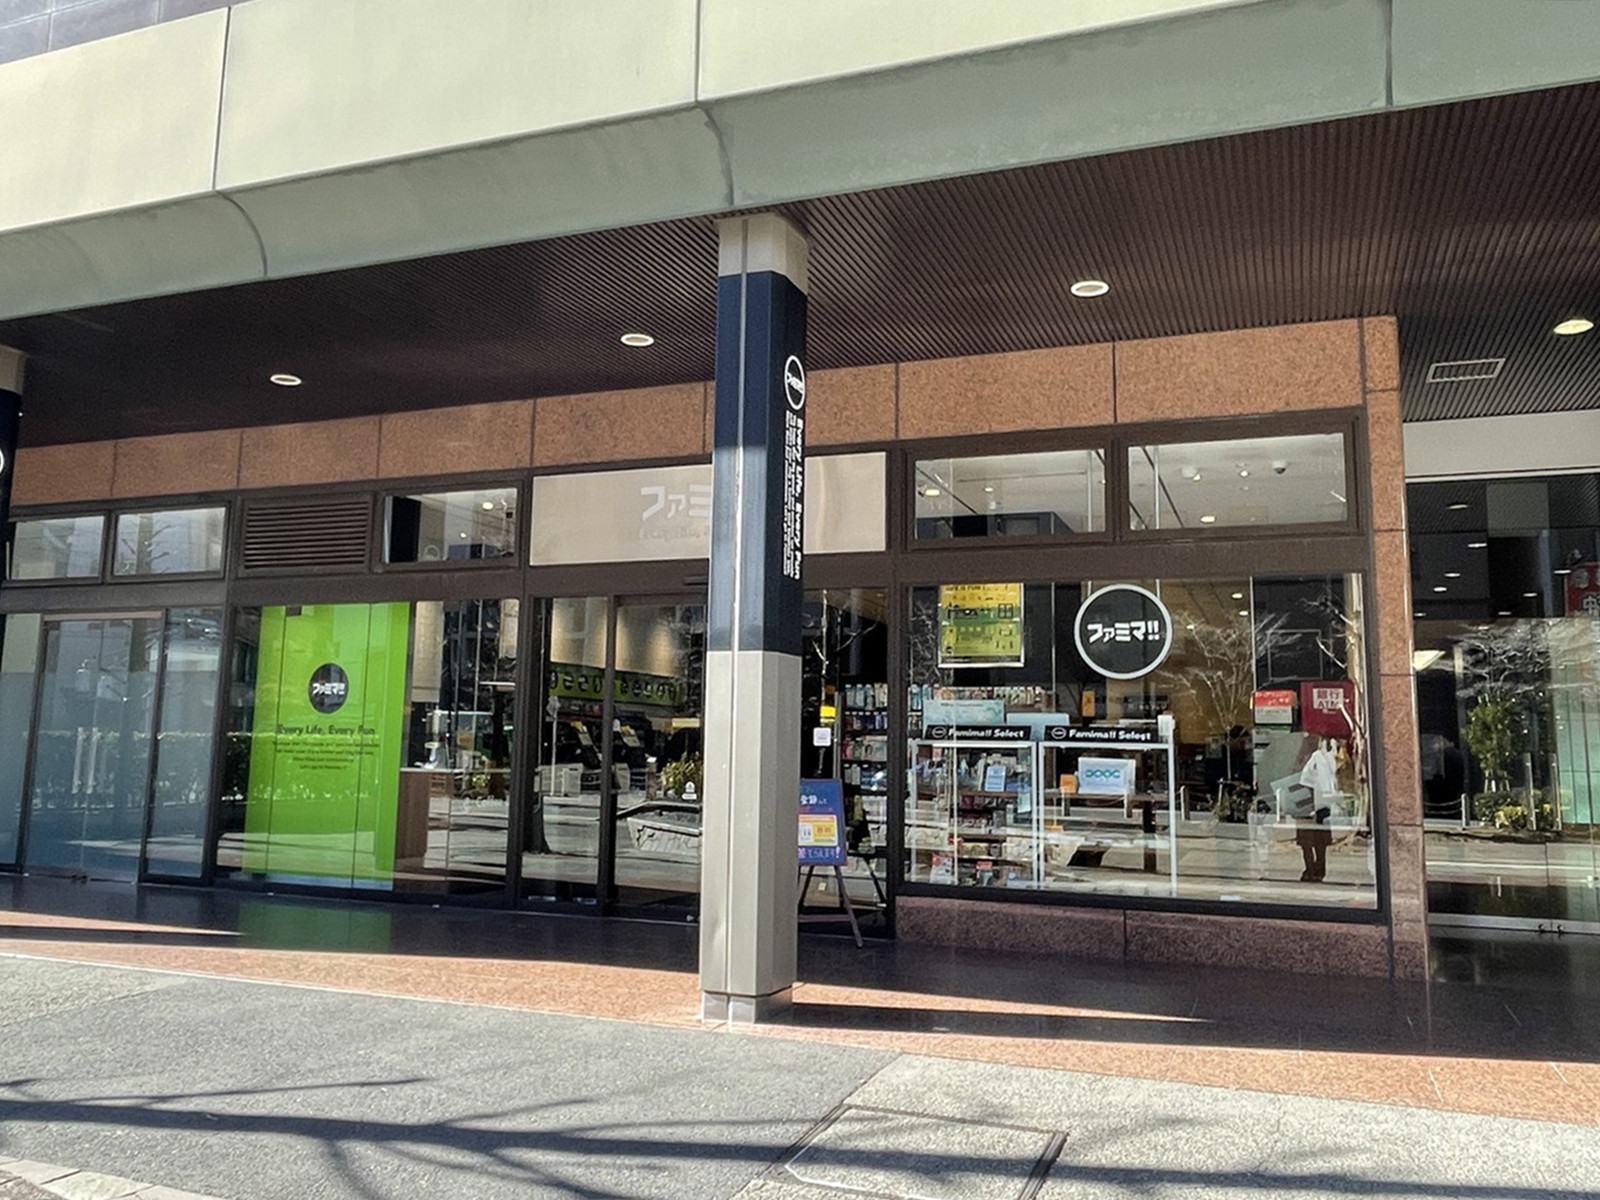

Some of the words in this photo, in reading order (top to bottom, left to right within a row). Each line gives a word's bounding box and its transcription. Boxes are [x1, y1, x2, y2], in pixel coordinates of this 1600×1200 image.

[1087, 620, 1160, 644] ファミマ!!
[279, 724, 303, 736] Every
[328, 725, 355, 737] Every
[358, 725, 376, 735] Fun
[993, 729, 1025, 738] Select
[1118, 730, 1151, 741] Select
